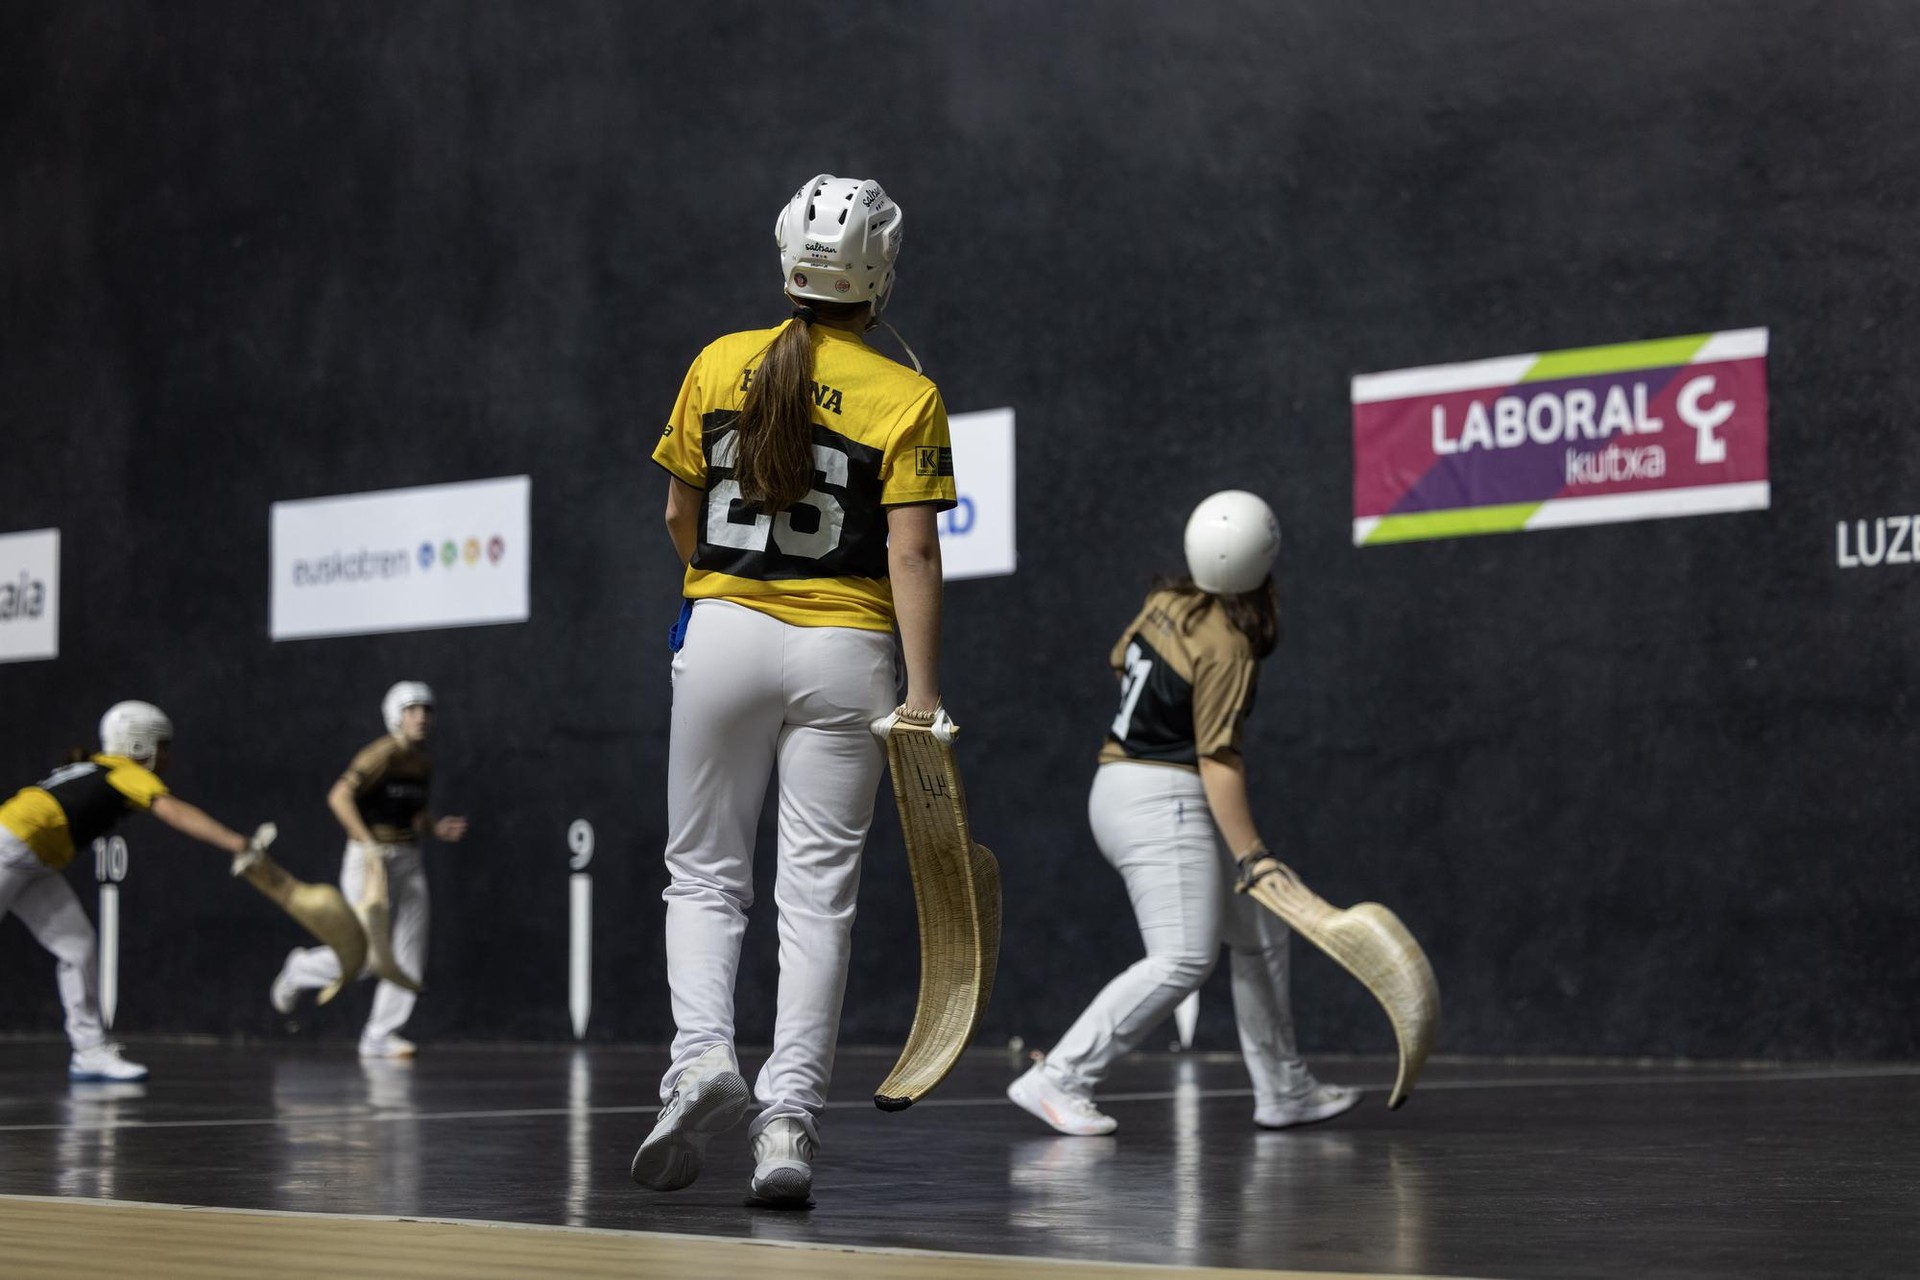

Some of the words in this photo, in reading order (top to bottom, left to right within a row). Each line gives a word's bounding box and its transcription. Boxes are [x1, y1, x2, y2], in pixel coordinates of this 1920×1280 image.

[1432, 382, 1664, 454] LABORAL
[1565, 444, 1666, 486] kutxa
[92, 835, 129, 882] 10
[567, 818, 595, 870] 9
